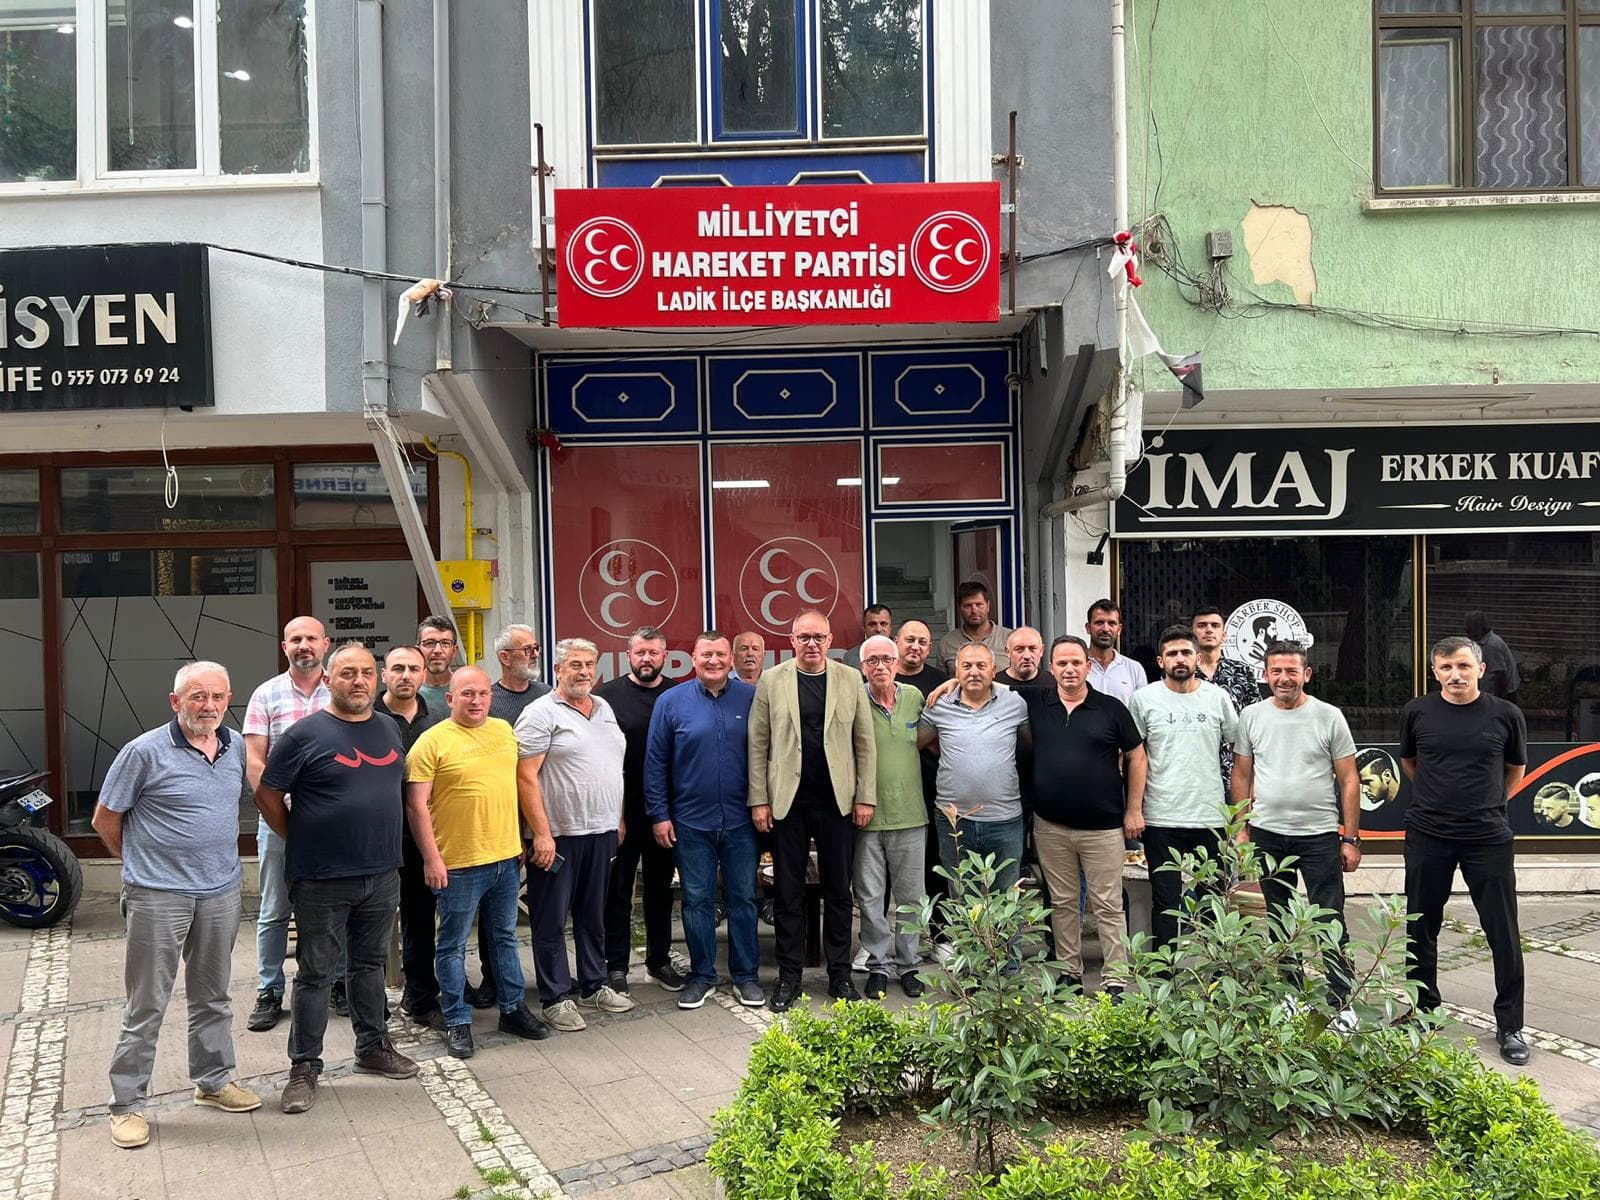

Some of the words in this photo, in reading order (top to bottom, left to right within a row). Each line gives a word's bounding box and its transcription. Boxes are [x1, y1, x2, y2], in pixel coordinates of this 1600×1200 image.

[698, 201, 858, 238] MİLLİYETÇİ
[652, 251, 786, 277] HAREKET
[795, 243, 905, 277] PARTİSİ
[657, 285, 717, 311] LADİK
[722, 285, 766, 312] İLÇE
[771, 283, 891, 312] BAŞKANLIĞI
[51, 370, 63, 386] 0
[67, 369, 95, 386] 555
[100, 368, 128, 385] 073
[133, 367, 154, 384] 69
[159, 367, 181, 383] 24
[1138, 435, 1355, 522] İMAJ
[1380, 453, 1498, 482] ERKEK
[1507, 451, 1600, 480] KUAF
[1454, 495, 1504, 513] Hair
[1509, 494, 1576, 517] Design
[1231, 602, 1270, 629] BARBER
[1273, 605, 1300, 629] SHOP
